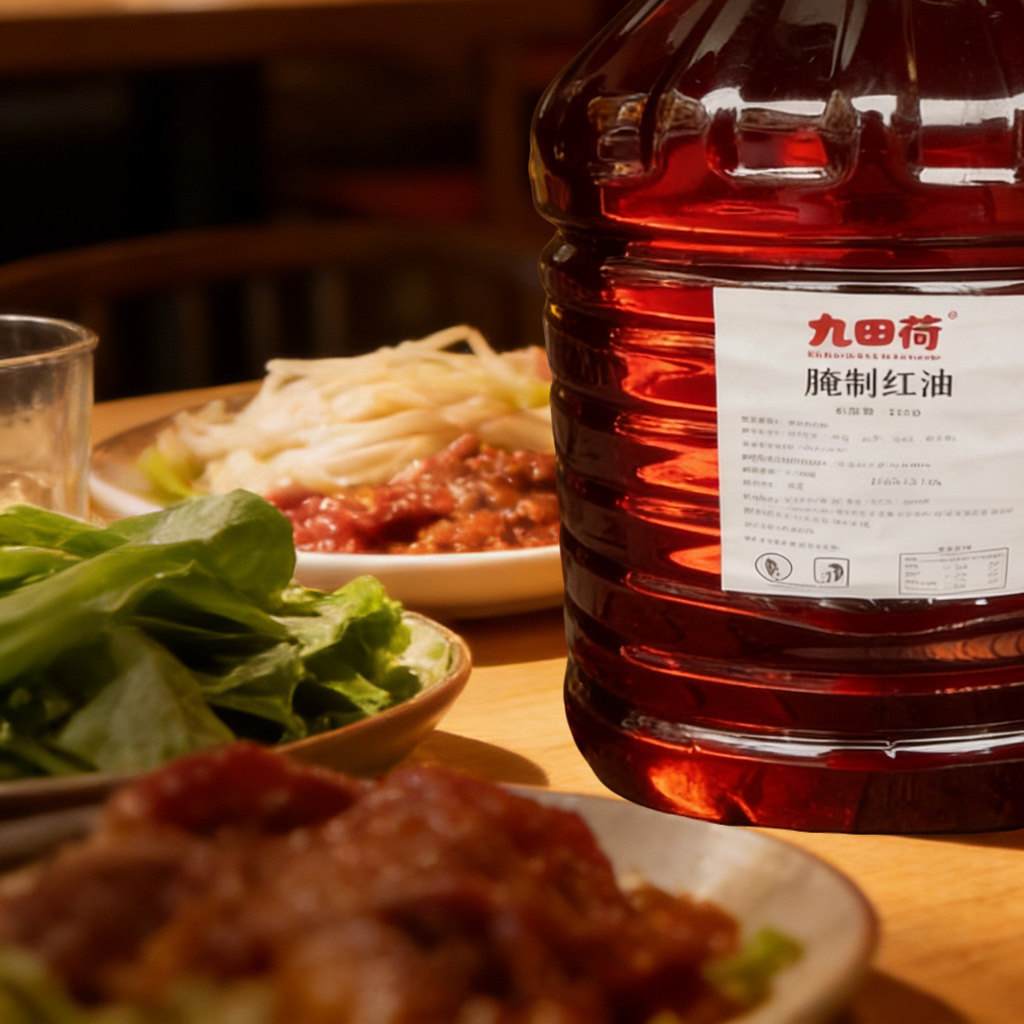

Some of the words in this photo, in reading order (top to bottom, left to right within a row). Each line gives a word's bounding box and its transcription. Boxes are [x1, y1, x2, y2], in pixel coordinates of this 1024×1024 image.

[808, 312, 942, 351] 九田荷
[804, 368, 953, 398] 腌制红油
